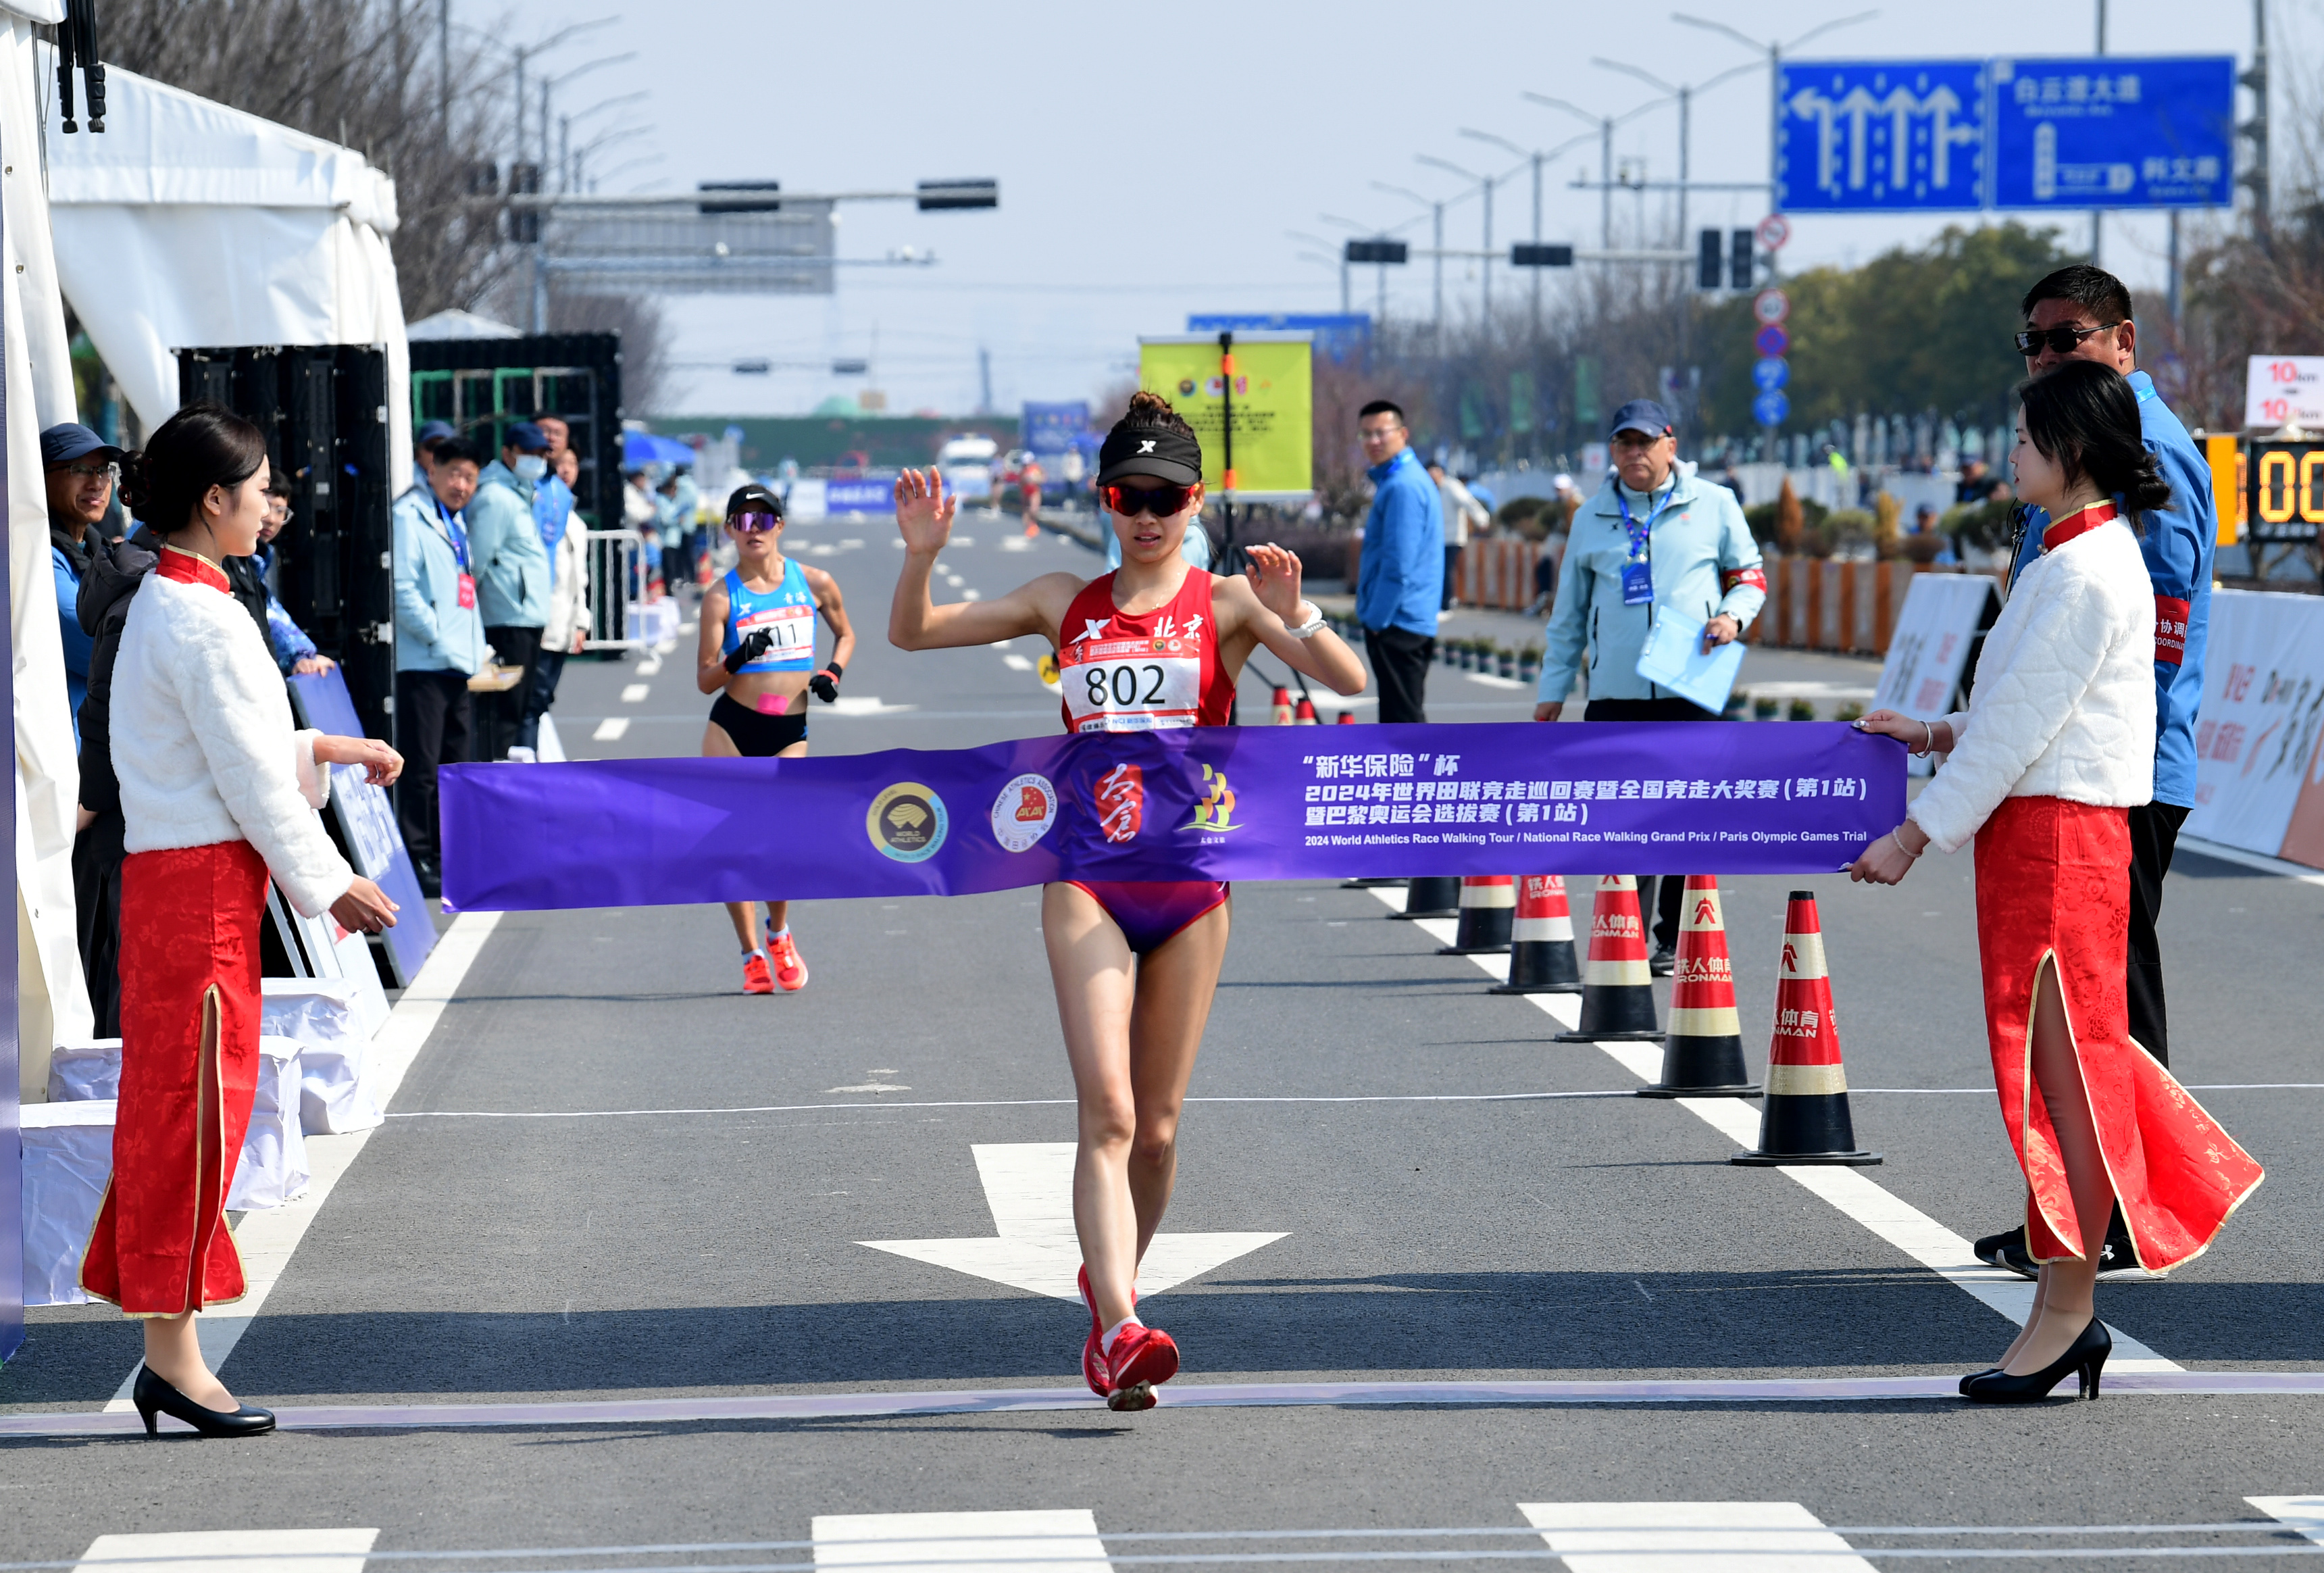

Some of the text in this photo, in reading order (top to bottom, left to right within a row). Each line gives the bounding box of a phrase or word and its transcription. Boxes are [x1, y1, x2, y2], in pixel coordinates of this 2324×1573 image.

[757, 623, 797, 647] 11
[1154, 614, 1204, 639] 北京
[2156, 618, 2188, 639] 协调
[1086, 665, 1165, 706] 802
[1305, 836, 1329, 846] 2024
[1331, 834, 1361, 845] World
[1363, 833, 1410, 845] Athletics
[1413, 833, 1440, 843] Race
[1442, 832, 1486, 845] Walking
[1489, 832, 1514, 843] Tour
[1523, 832, 1569, 843] National
[1573, 832, 1601, 842] Race
[1604, 831, 1648, 844] Walking
[1650, 831, 1685, 842] Grand
[1689, 831, 1711, 841] Prix
[1720, 831, 1748, 842] Paris
[1751, 831, 1798, 843] Olympic
[1800, 831, 1840, 841] Games
[1842, 830, 1867, 841] Trial
[1593, 914, 1640, 930] 人体育
